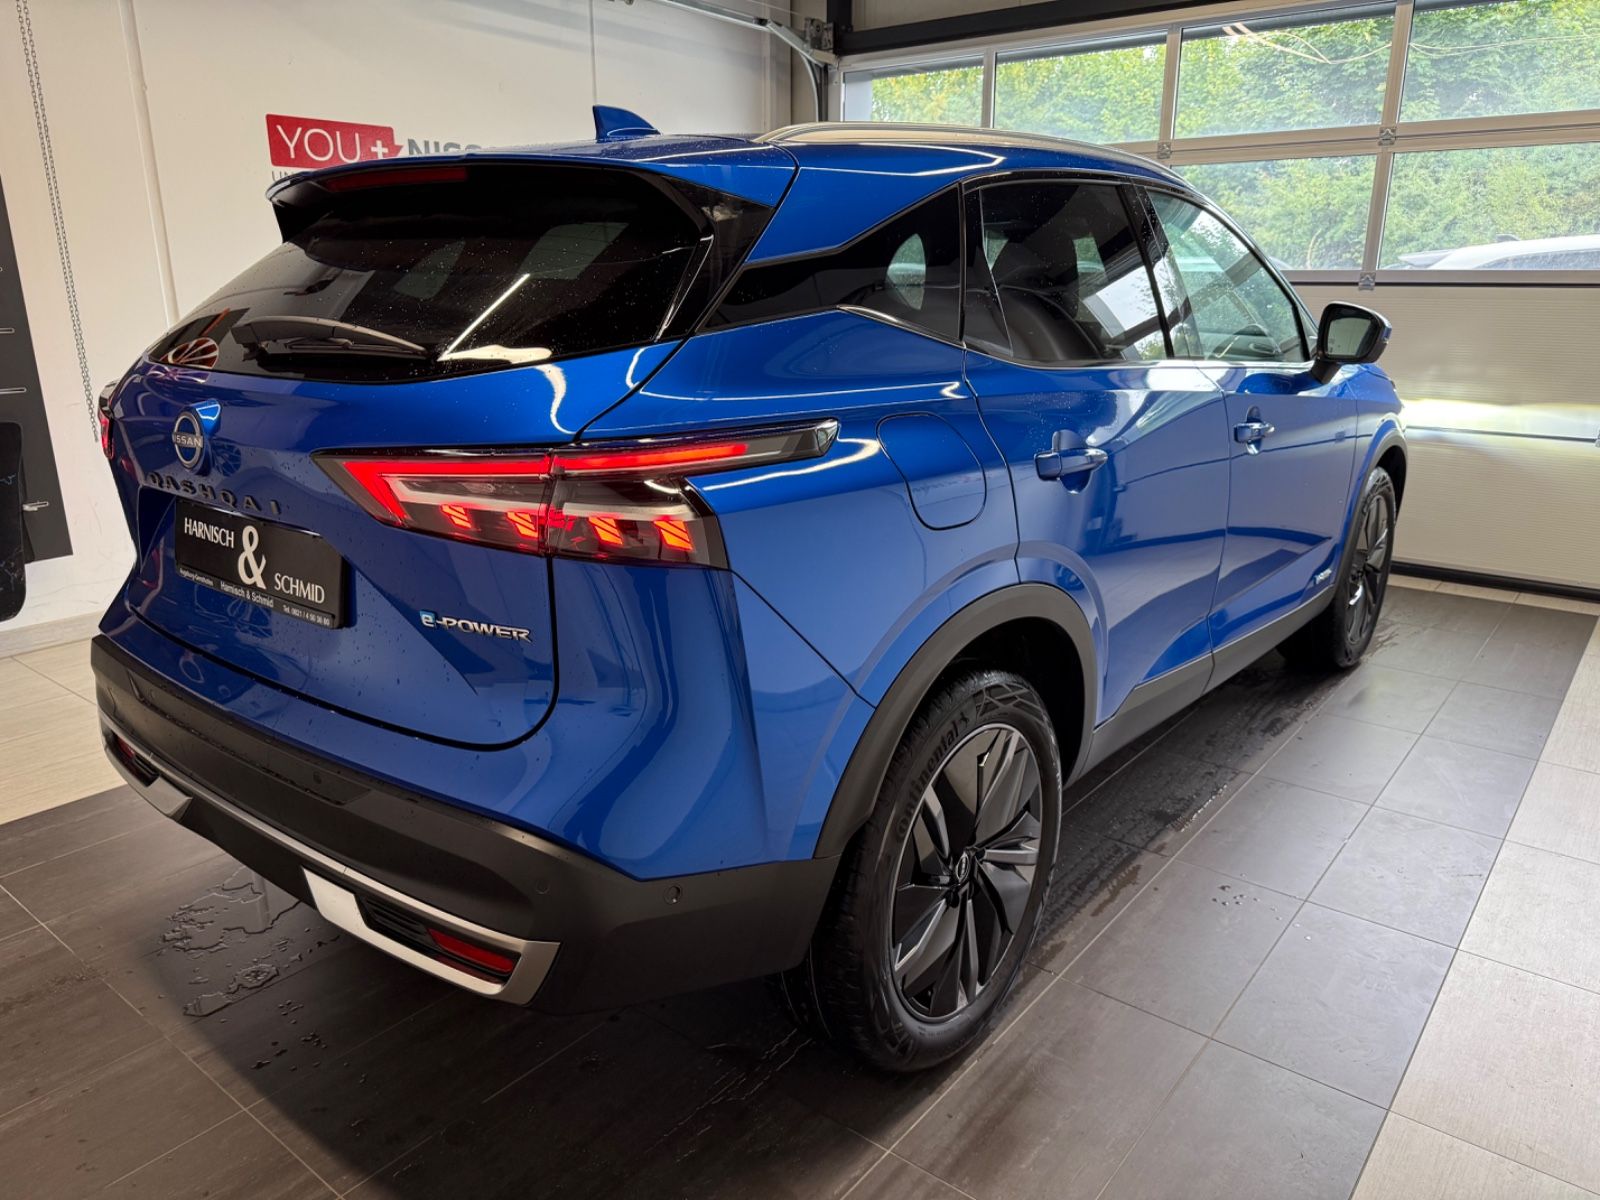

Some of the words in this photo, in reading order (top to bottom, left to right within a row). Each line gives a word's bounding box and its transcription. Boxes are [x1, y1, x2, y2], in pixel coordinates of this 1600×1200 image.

[276, 124, 360, 163] YOU
[147, 472, 281, 515] QASHQAI
[184, 517, 235, 548] HARNISCH
[238, 525, 266, 589] &
[274, 572, 325, 604] SCHMID
[220, 580, 245, 598] Harnisch
[252, 592, 274, 608] Schmid
[420, 611, 532, 642] e-POWER
